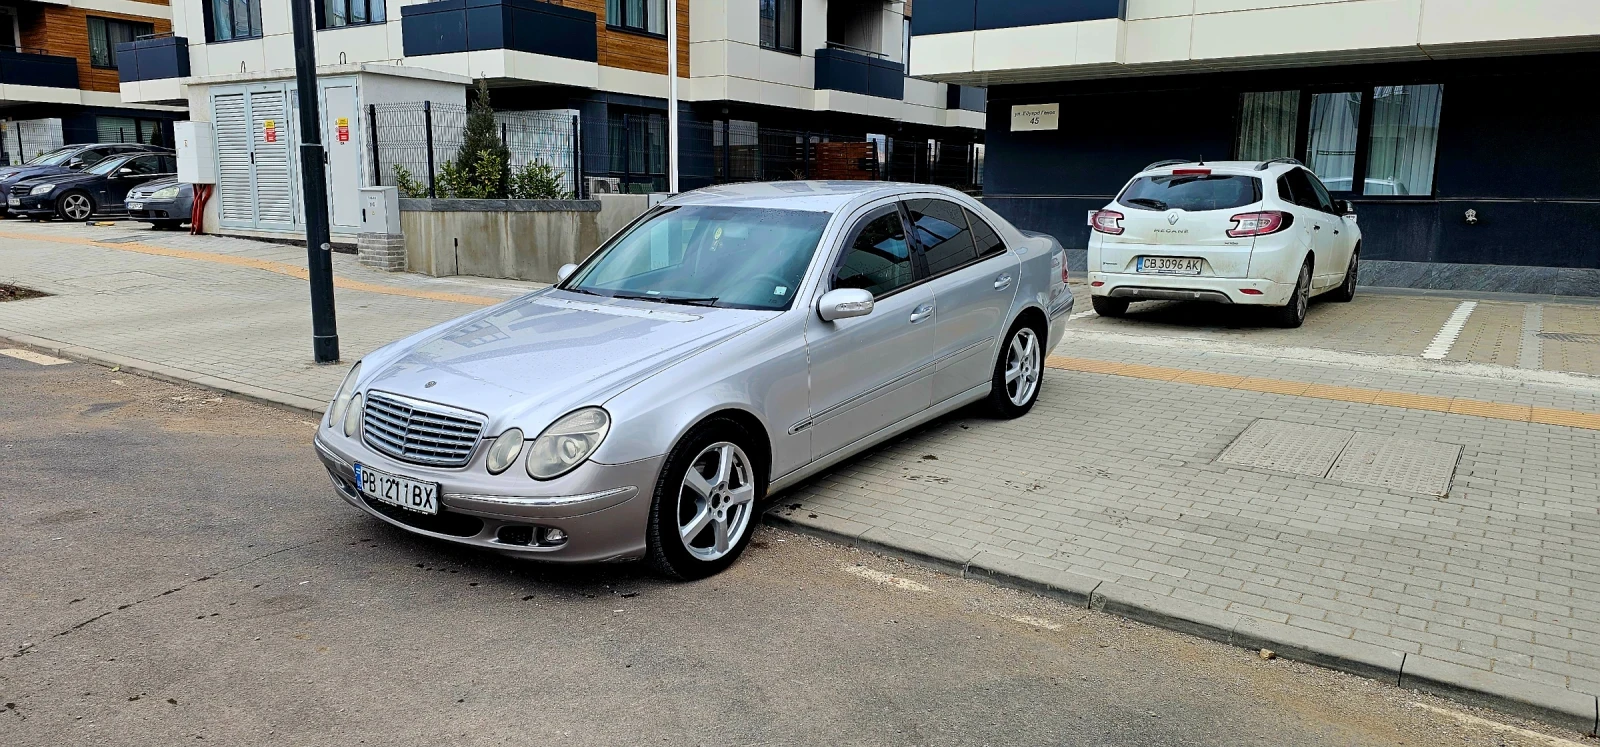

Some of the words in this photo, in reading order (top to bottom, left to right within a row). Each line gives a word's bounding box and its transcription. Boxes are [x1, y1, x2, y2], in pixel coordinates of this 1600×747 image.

[1143, 258, 1157, 269] CB
[1158, 259, 1184, 270] 3096
[1185, 260, 1199, 270] AK
[362, 470, 376, 493] PB
[379, 477, 409, 504] 1211
[412, 485, 433, 509] BX
